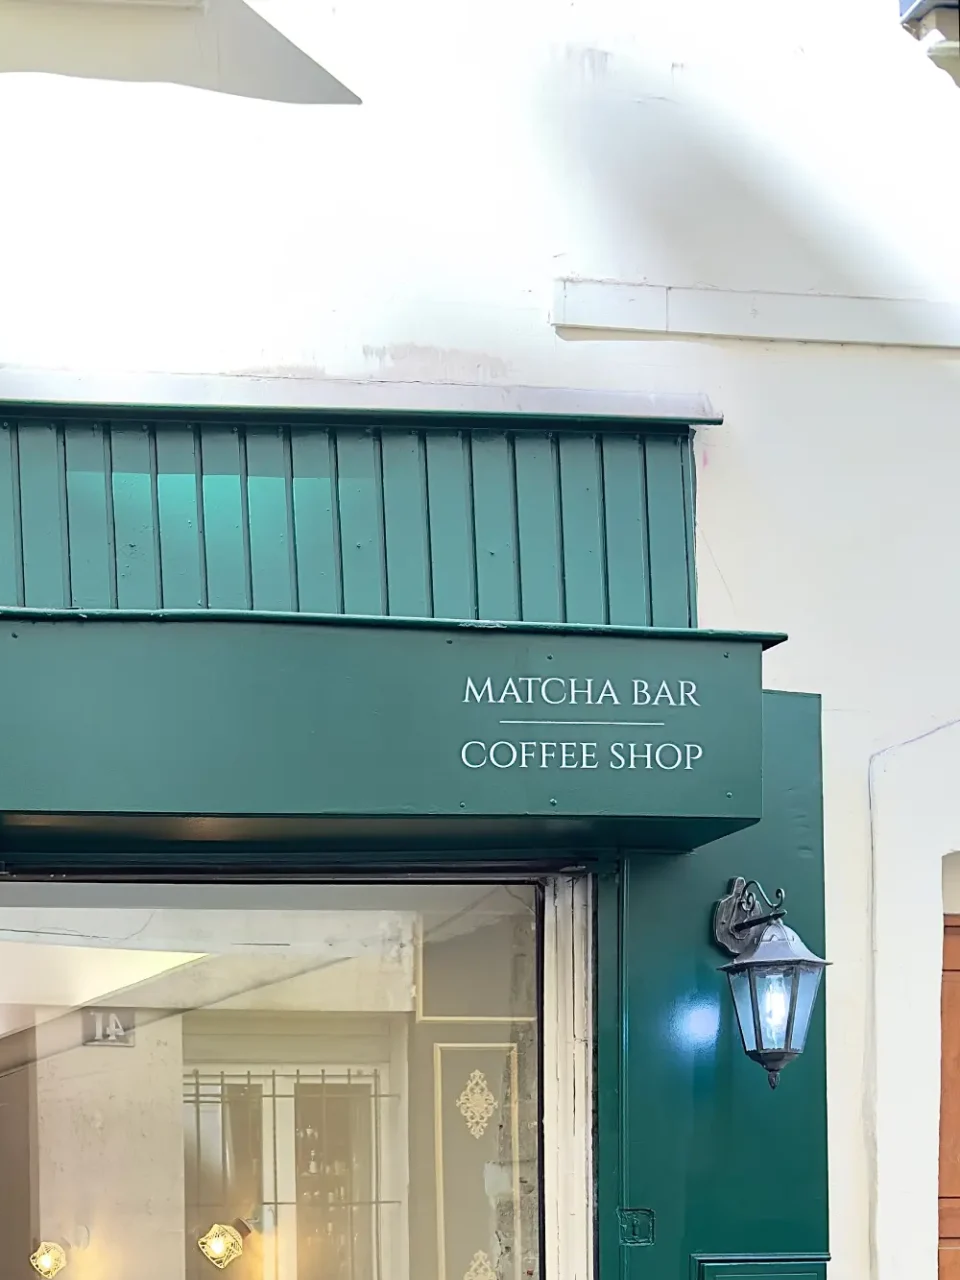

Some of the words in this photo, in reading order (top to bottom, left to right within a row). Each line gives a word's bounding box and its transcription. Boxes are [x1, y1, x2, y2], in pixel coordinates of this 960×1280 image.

[461, 676, 621, 705] MATCHA
[631, 679, 701, 707] BAR
[460, 741, 599, 769] COFFEE
[609, 742, 703, 771] SHOP
